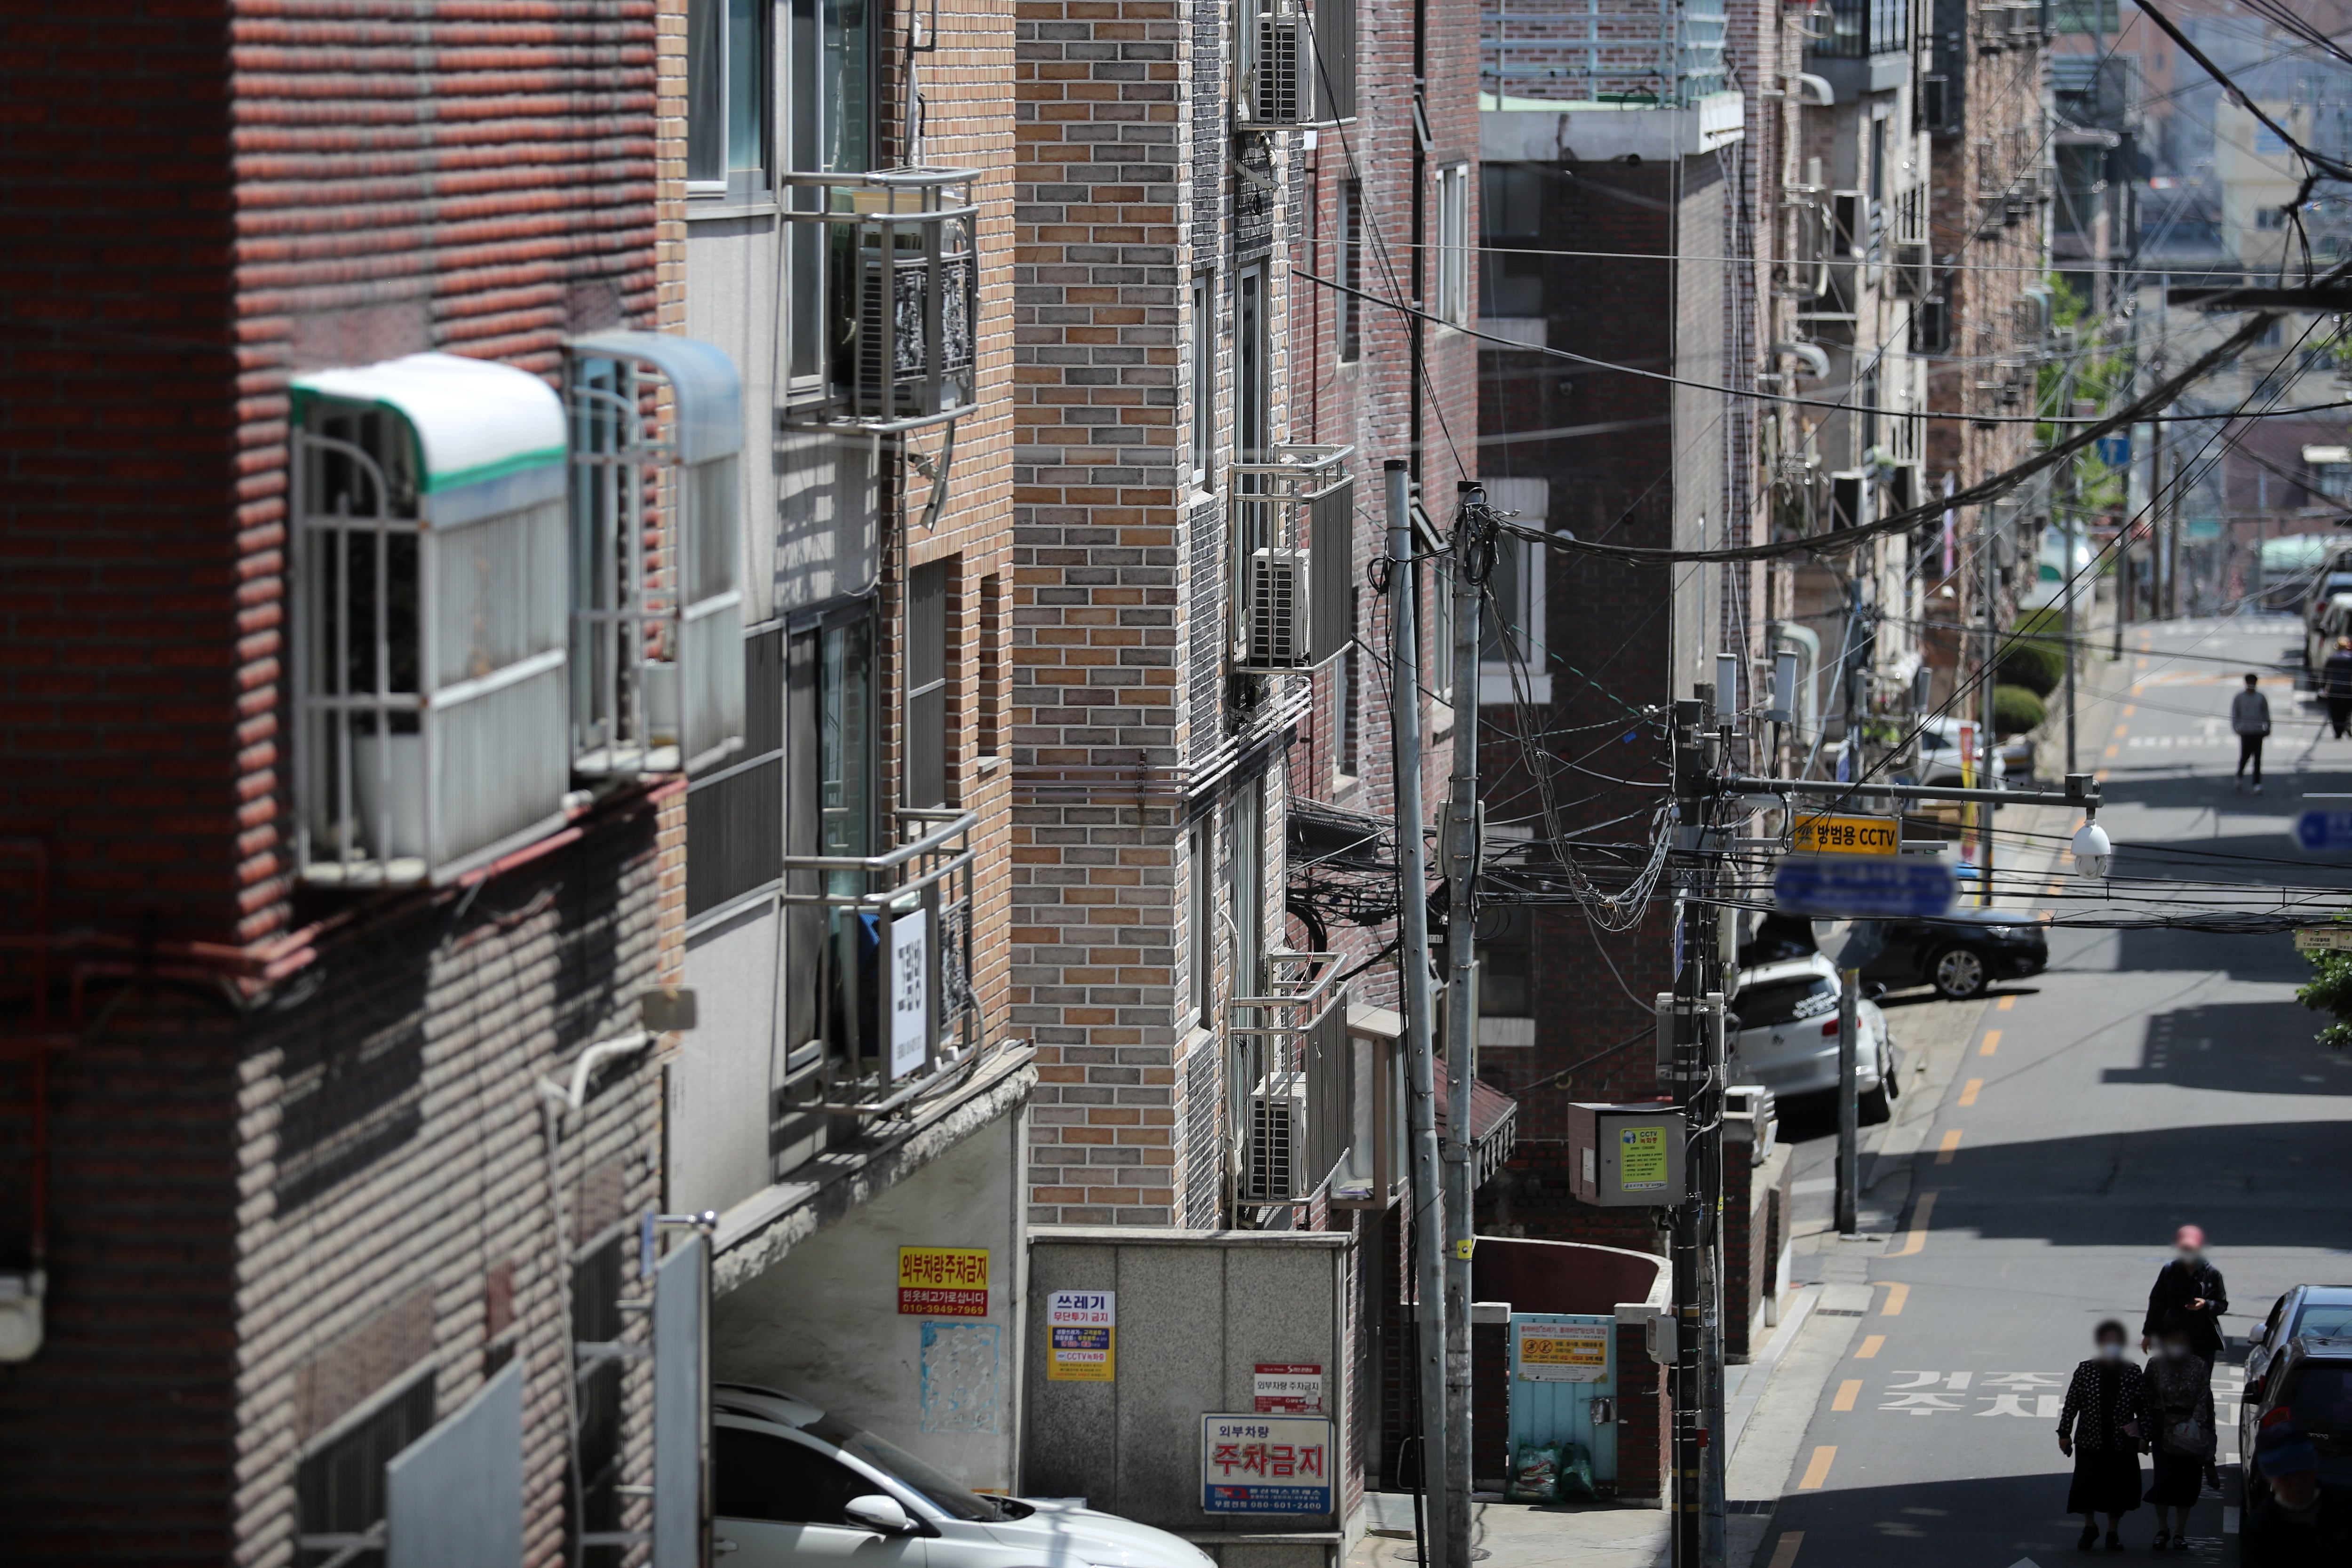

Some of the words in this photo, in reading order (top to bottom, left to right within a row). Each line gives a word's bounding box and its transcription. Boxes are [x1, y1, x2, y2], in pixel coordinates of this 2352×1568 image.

[1818, 825, 1855, 845] 방범용
[1859, 828, 1895, 846] CCTV
[902, 1254, 986, 1285] 외부차량주차금지
[903, 1289, 985, 1305] 헌옷최고가로삽니다
[1057, 1296, 1104, 1309] 쓰레기
[903, 1304, 984, 1314] 010-3949-7969
[1054, 1312, 1088, 1321] 무단투기
[1092, 1313, 1108, 1322] 금지
[1258, 1381, 1287, 1390] 외부차량
[1289, 1382, 1319, 1391] 주차금지
[1219, 1425, 1270, 1438] 외부차량
[2307, 1432, 2329, 1441] orning
[1214, 1443, 1324, 1478] 주차금지
[1251, 1501, 1321, 1510] 080-601-2400
